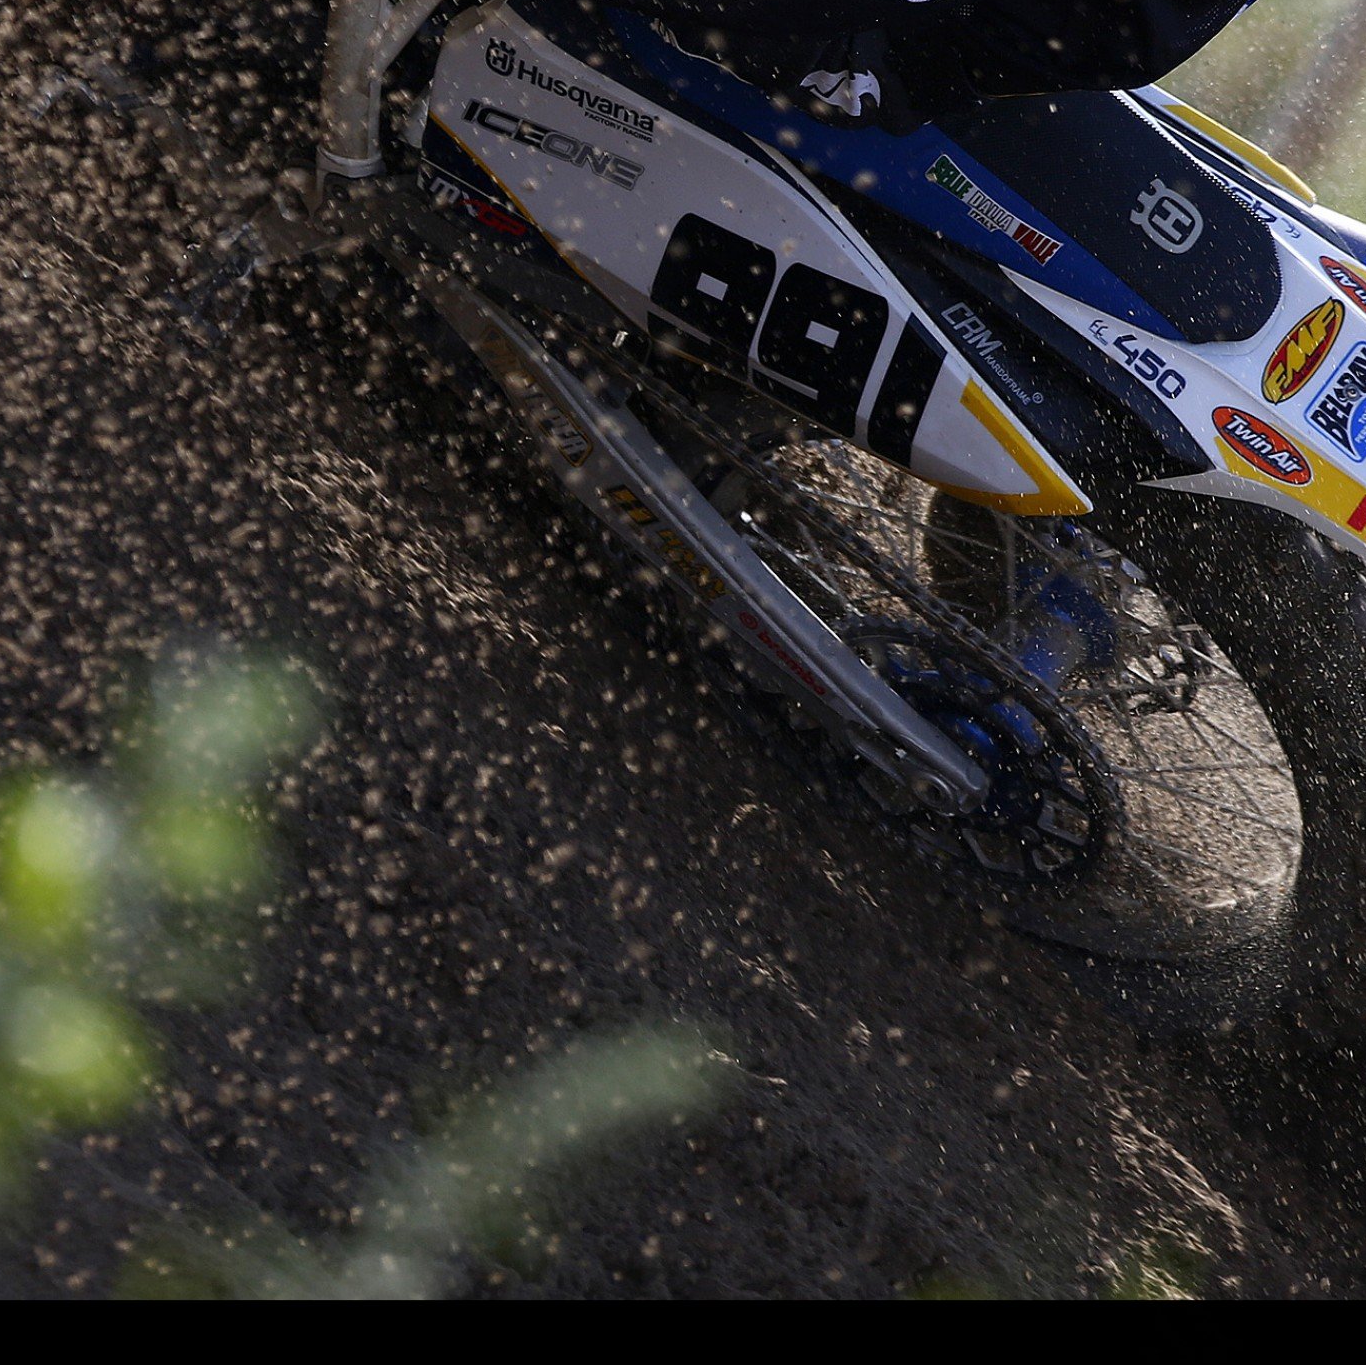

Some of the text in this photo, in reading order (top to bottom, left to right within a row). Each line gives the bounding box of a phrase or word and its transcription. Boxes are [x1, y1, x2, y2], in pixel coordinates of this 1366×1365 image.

[517, 59, 655, 133] Husqvarna
[584, 110, 654, 144] FACTORY RACING
[967, 189, 1014, 232] DALLA
[1012, 222, 1061, 265] VALLE
[969, 210, 1001, 233] ITALY
[1330, 266, 1358, 290] Air
[940, 302, 1003, 357] CRM
[1265, 296, 1338, 406] FMF
[1112, 333, 1187, 399] 450
[1224, 413, 1304, 476] Twin Air
